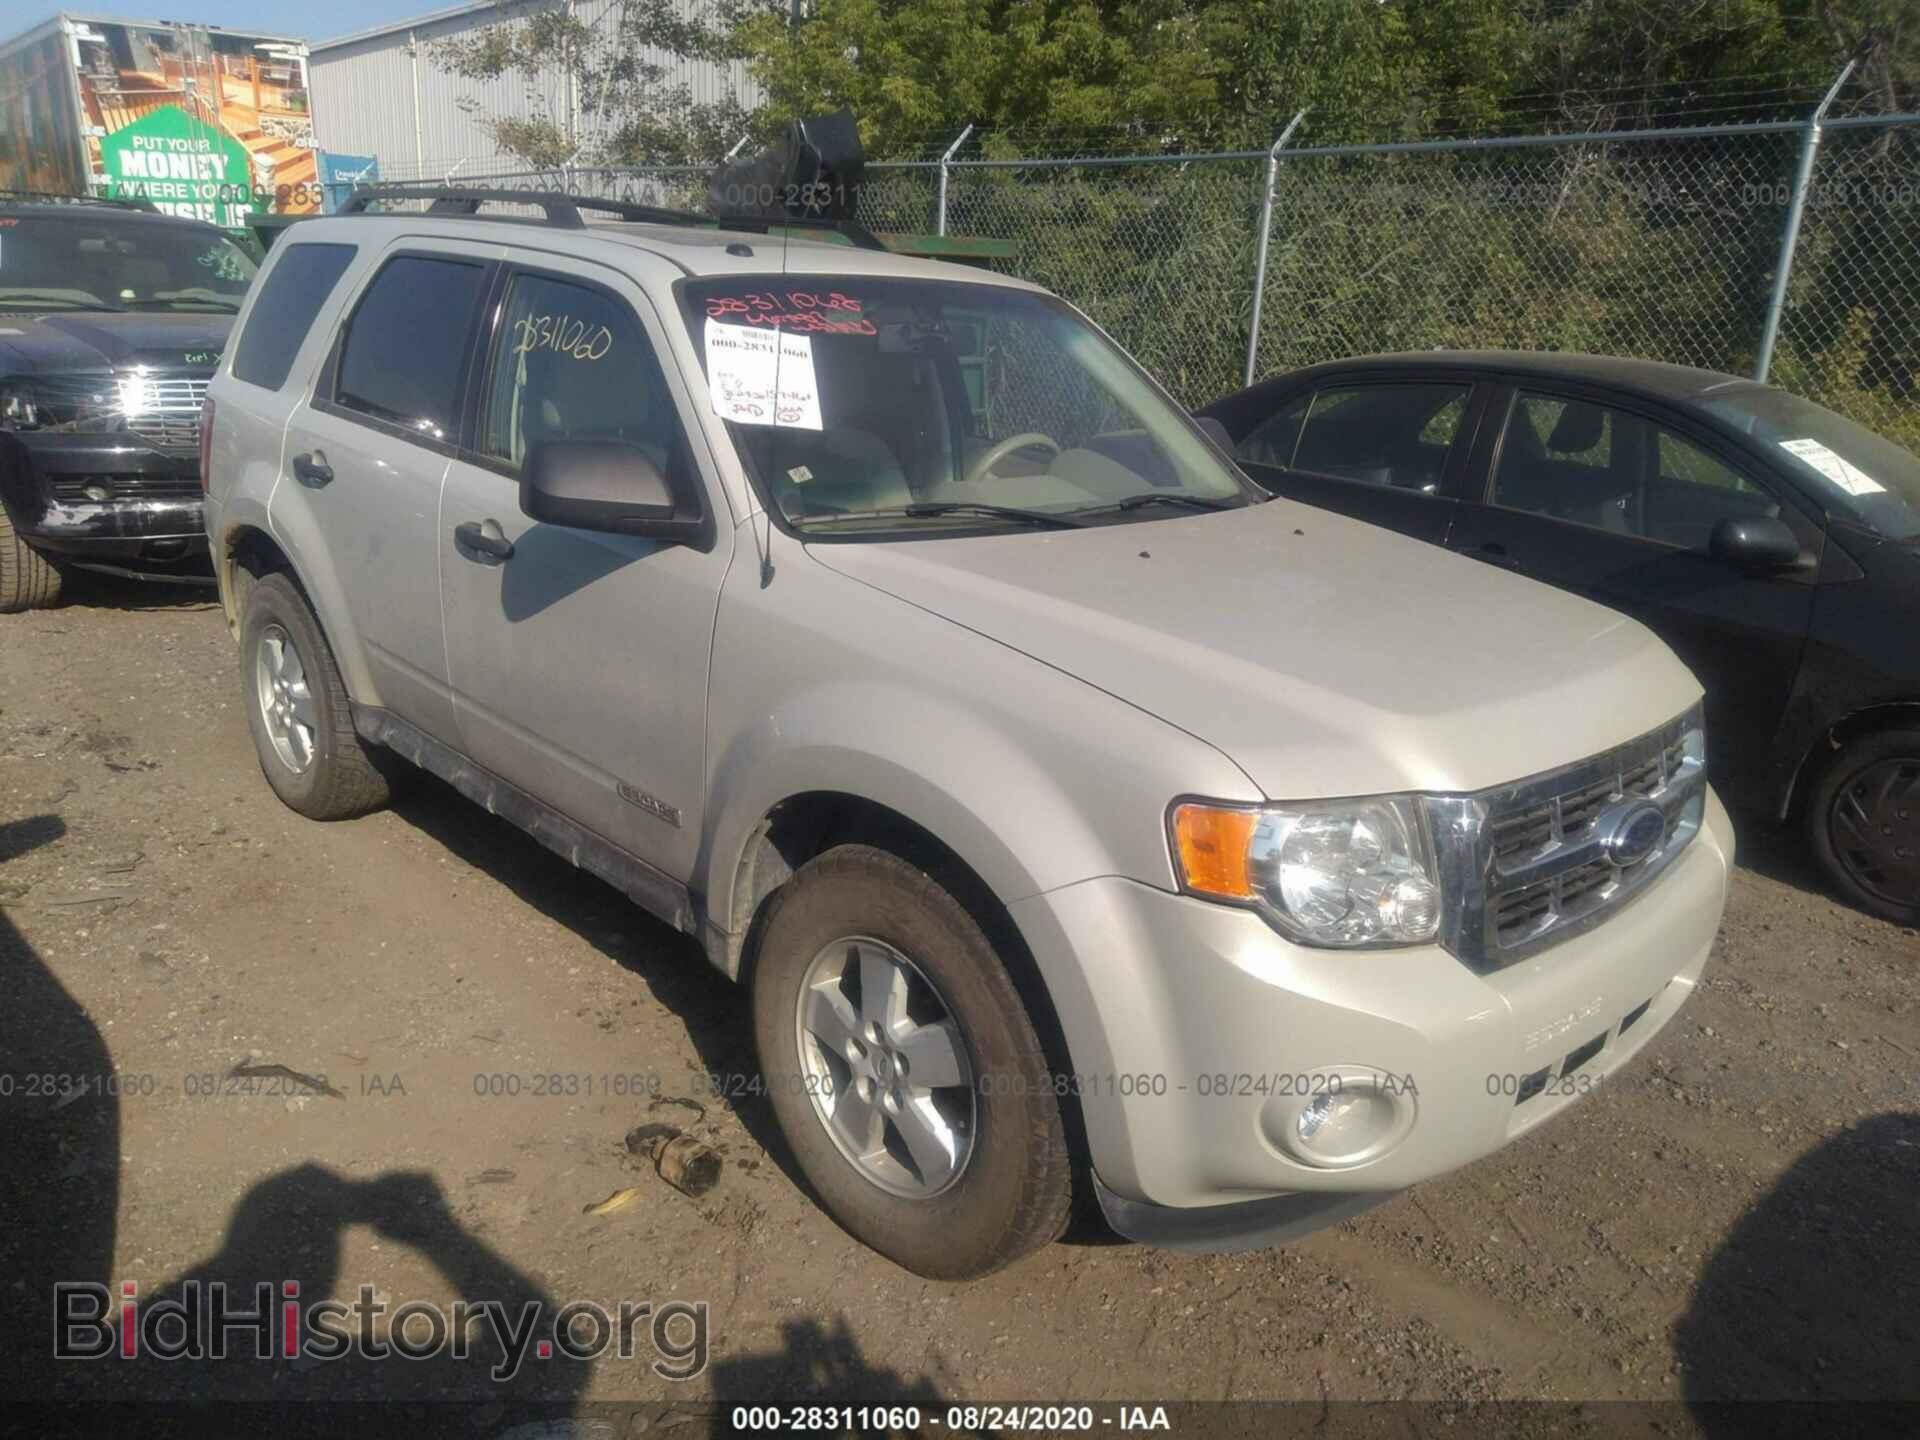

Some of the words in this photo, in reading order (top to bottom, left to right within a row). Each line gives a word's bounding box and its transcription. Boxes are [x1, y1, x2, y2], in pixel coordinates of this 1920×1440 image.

[132, 136, 165, 149] PUT
[167, 138, 210, 152] YOUR
[118, 150, 229, 180] MONEY
[513, 312, 612, 359] 28311060
[711, 339, 808, 359] 000-2831060
